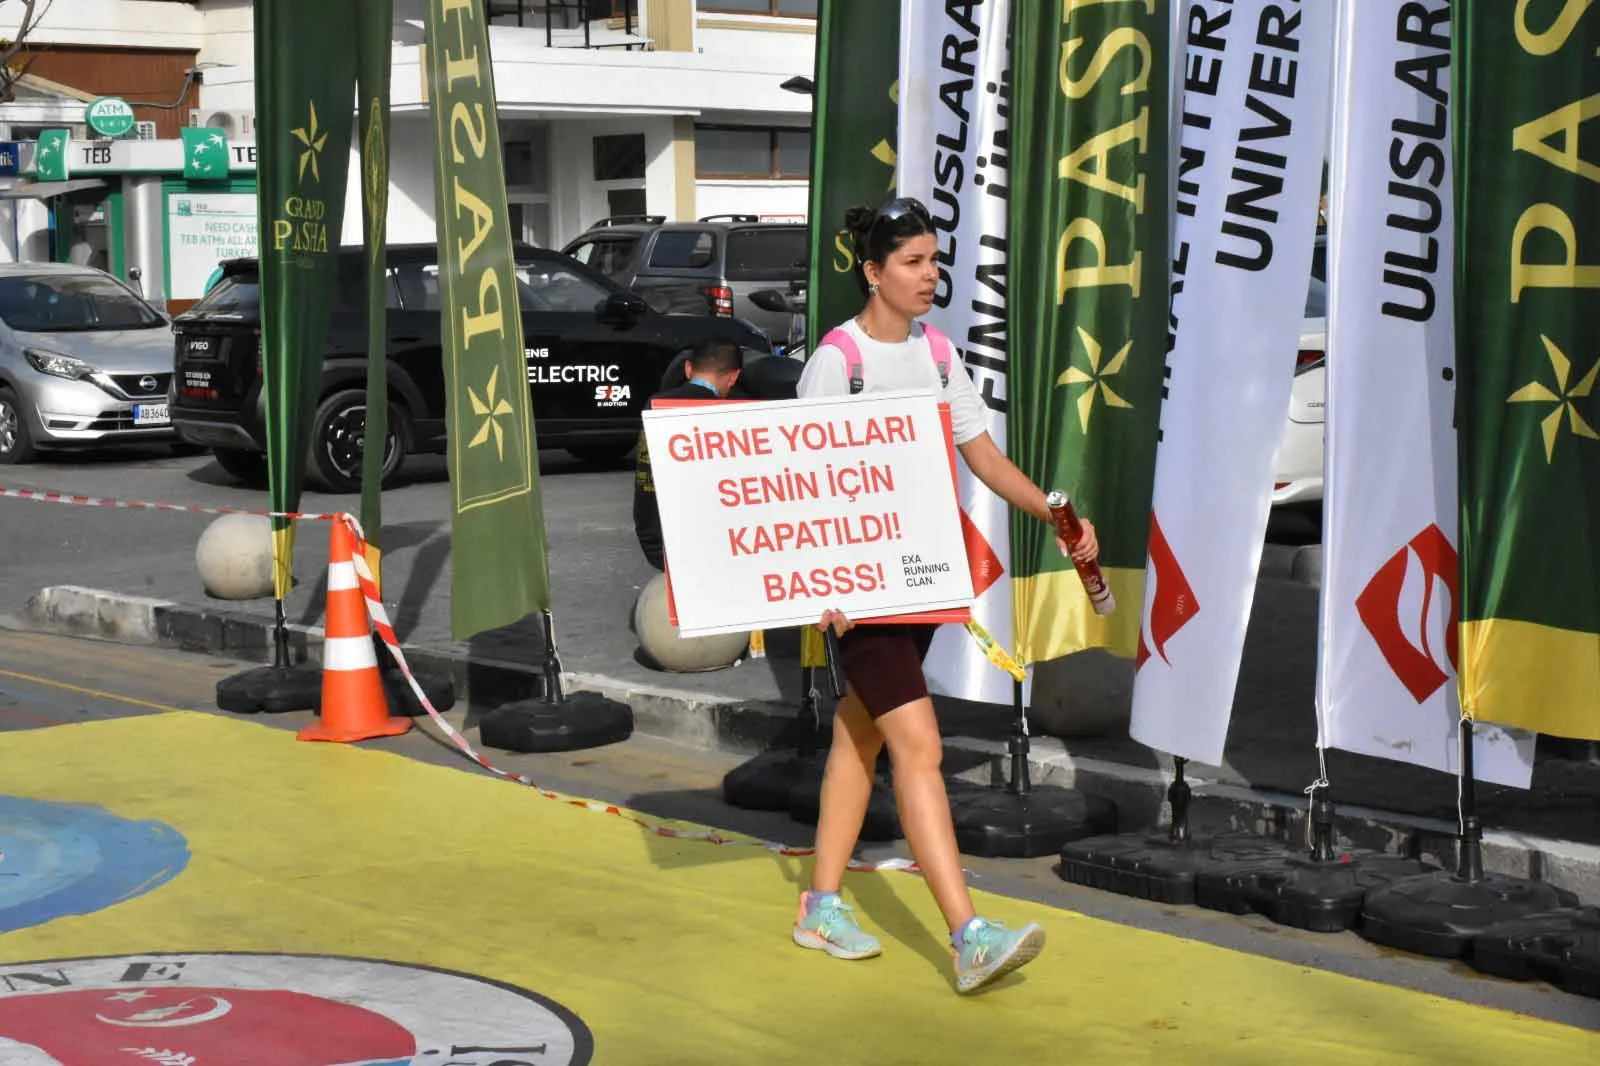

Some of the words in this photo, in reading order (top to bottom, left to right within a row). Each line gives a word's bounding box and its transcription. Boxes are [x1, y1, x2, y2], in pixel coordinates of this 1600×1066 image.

[1056, 0, 1155, 305] PAS
[1215, 0, 1302, 271] UNIVER
[83, 147, 112, 164] TEB
[1381, 0, 1451, 322] ULUSLAR
[190, 341, 209, 350] VIGO
[527, 365, 620, 383] ELECTRIC
[668, 426, 773, 462] GİRNE
[778, 415, 917, 452] YOLLARI
[718, 467, 820, 507] SENİN
[826, 460, 895, 502] İÇİN
[728, 512, 903, 556] KAPATILDI!
[902, 554, 922, 564] EXA
[904, 562, 951, 576] RUNNING
[763, 563, 887, 602] BASSS!
[906, 576, 936, 587] CLAN.
